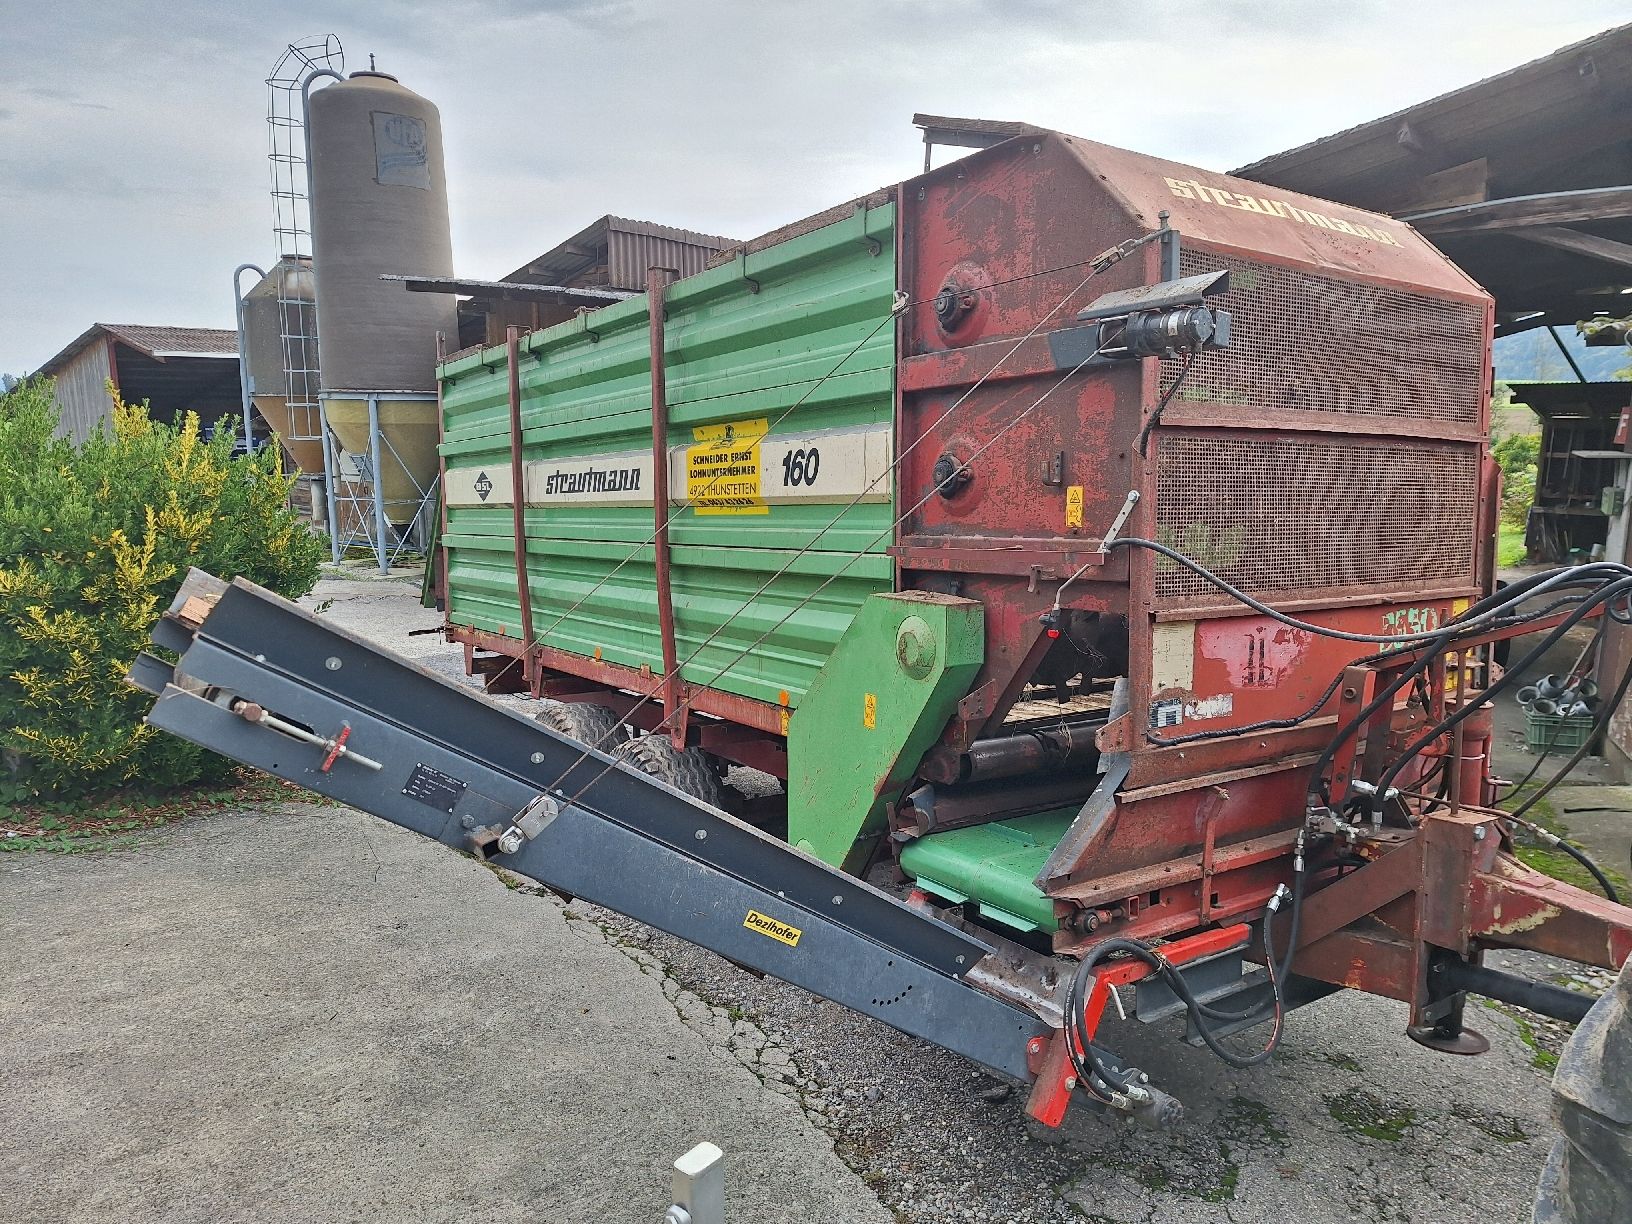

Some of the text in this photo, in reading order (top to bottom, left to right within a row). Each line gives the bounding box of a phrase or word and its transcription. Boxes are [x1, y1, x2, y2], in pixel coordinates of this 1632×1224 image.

[692, 451, 752, 465] SCHNEIDER ERNST
[782, 447, 820, 487] 160
[545, 466, 640, 495] strautmann
[690, 465, 756, 478] LOHNUNTERNEHMER
[708, 482, 757, 496] THUNSTETTEN
[746, 912, 799, 941] Dezlhofer
